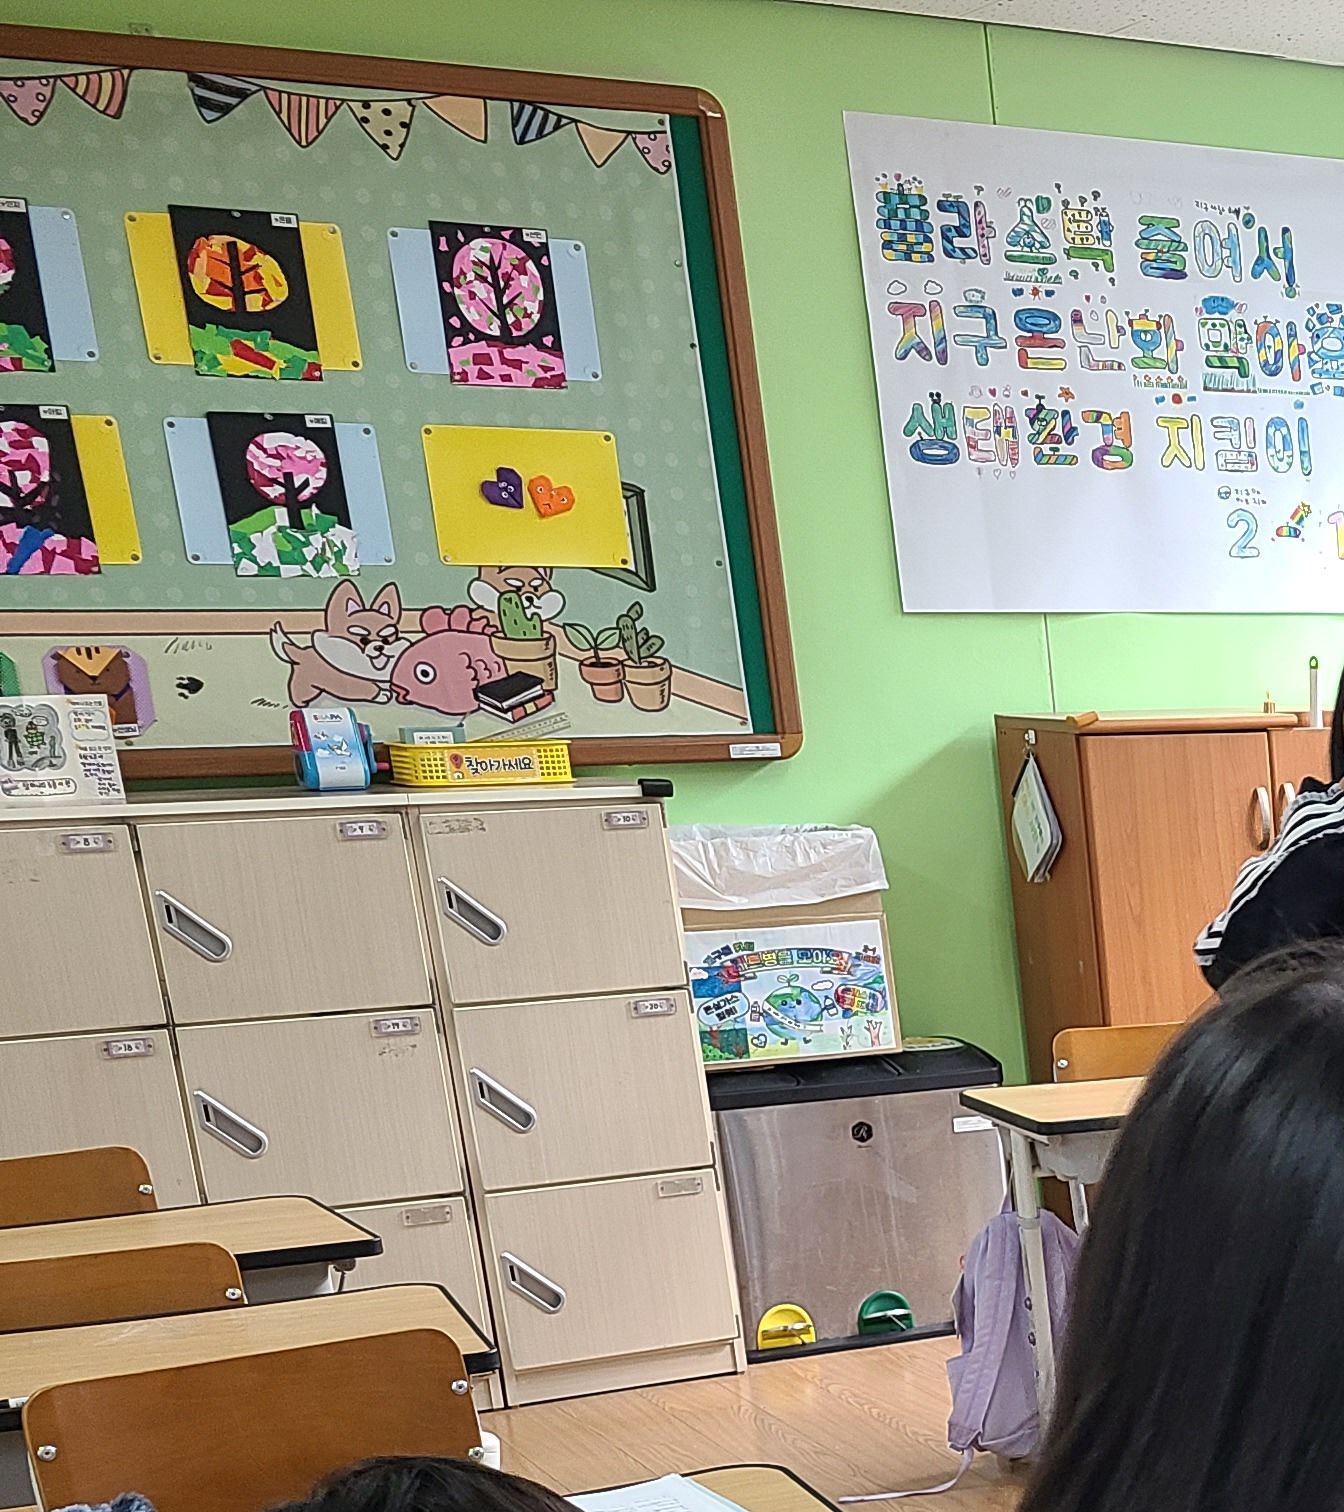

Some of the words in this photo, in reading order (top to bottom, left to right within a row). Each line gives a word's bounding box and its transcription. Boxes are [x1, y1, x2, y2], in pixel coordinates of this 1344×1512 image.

[876, 189, 1115, 273] 플라스틱
[1135, 215, 1296, 286] 줄여서
[888, 300, 1184, 374] 지구온난화
[903, 402, 1134, 471] 생태환경
[1156, 414, 1311, 476] 지킴이
[465, 755, 535, 776] 찾아가세요
